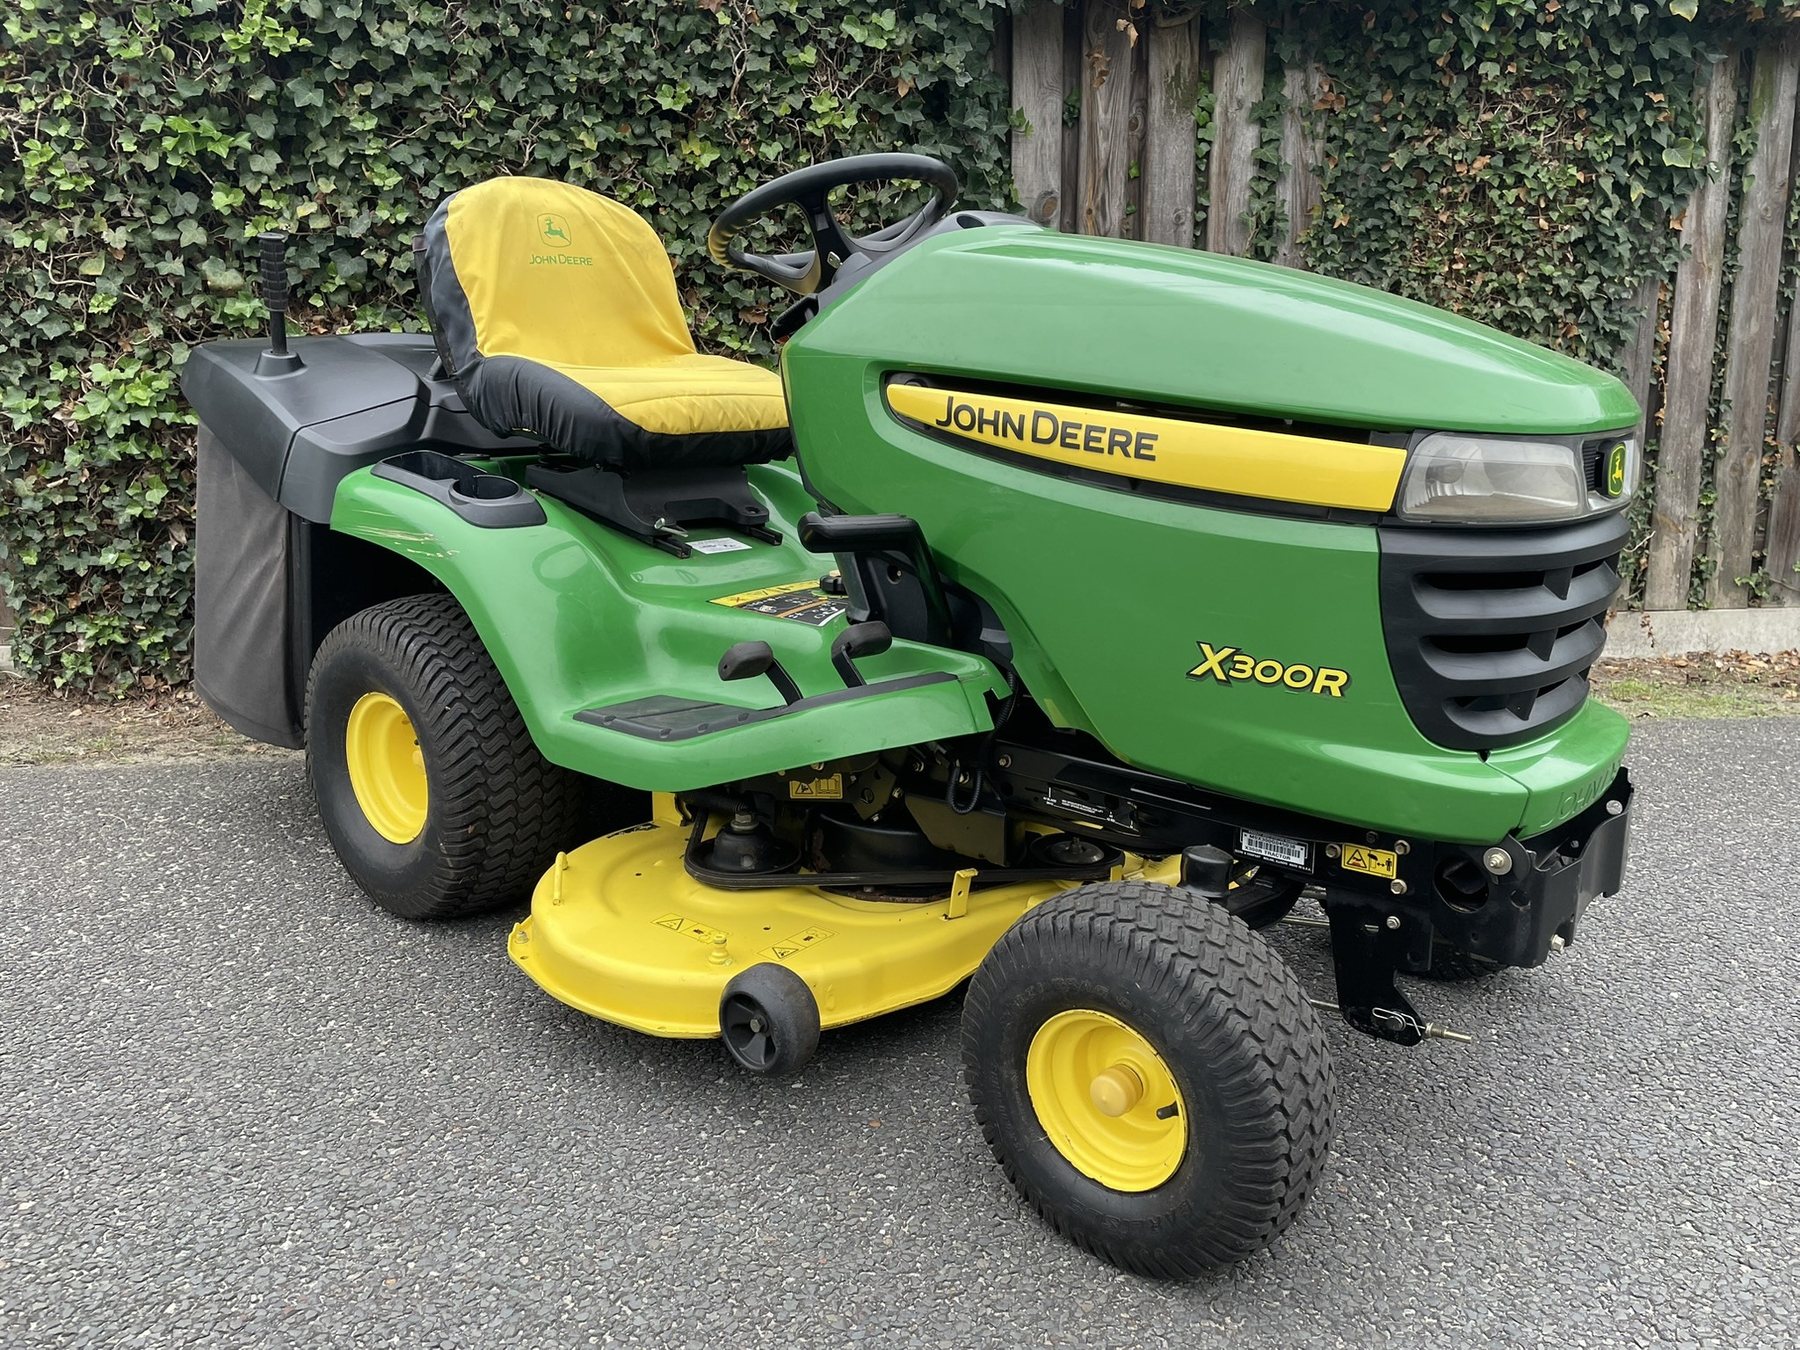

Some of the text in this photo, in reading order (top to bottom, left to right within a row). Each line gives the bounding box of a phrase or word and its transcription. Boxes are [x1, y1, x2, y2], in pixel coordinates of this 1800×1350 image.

[529, 254, 593, 265] JOHN DEERE
[936, 396, 1159, 461] JOHN DEERE
[1186, 641, 1351, 697] X300R
